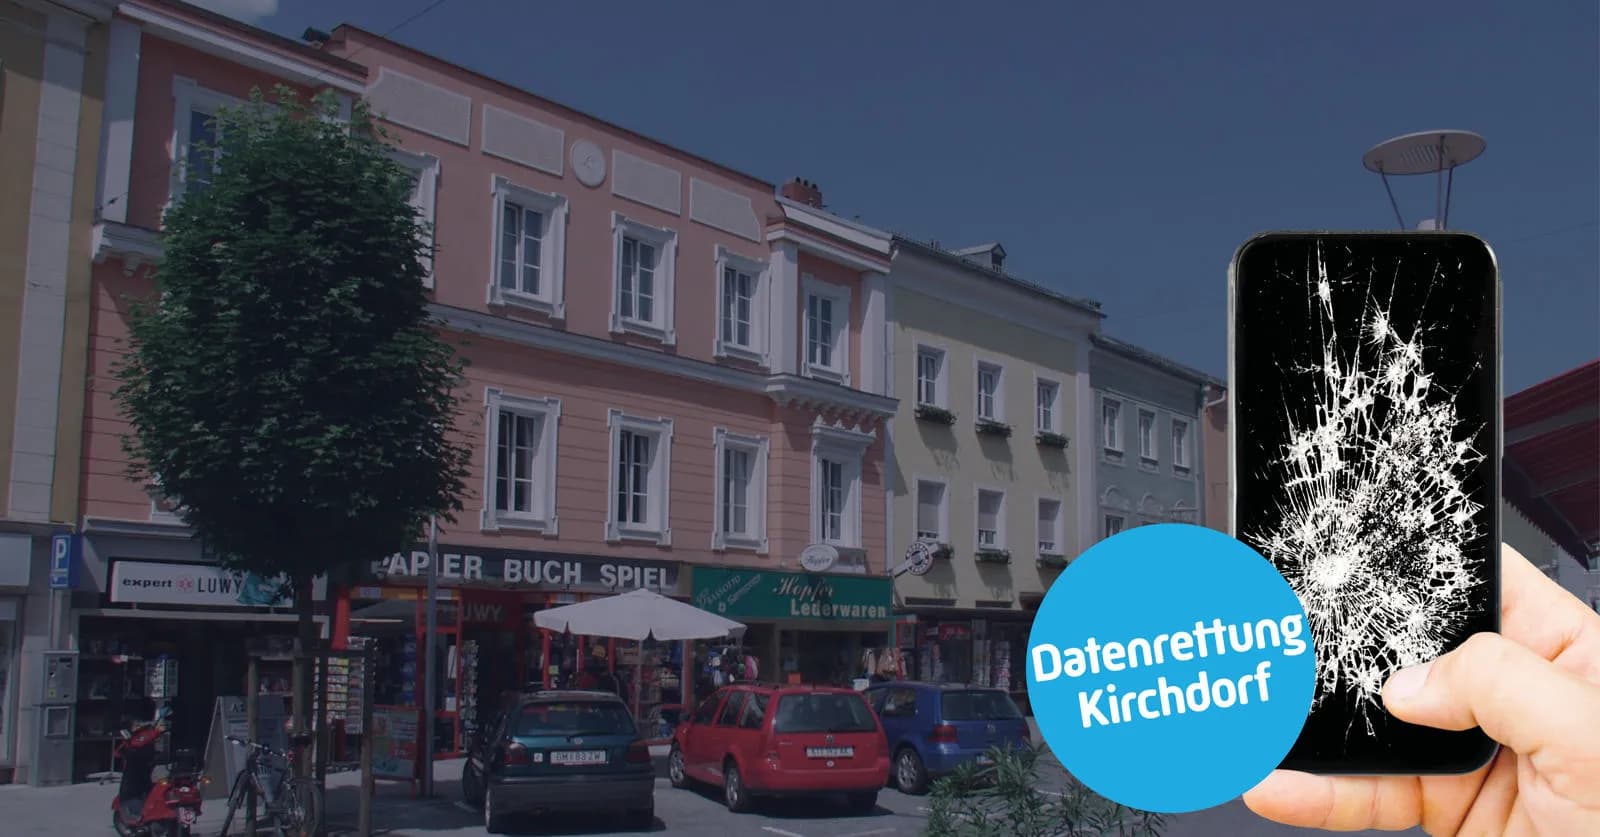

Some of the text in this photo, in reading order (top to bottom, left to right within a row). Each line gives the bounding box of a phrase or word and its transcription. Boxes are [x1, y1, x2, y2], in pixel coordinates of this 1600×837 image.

[55, 538, 67, 569] P
[122, 577, 242, 595] expert LUWY
[504, 559, 582, 585] BUCH
[599, 564, 673, 590] SPIEL
[773, 575, 833, 602] Hopfer
[790, 598, 886, 618] Lederwaren
